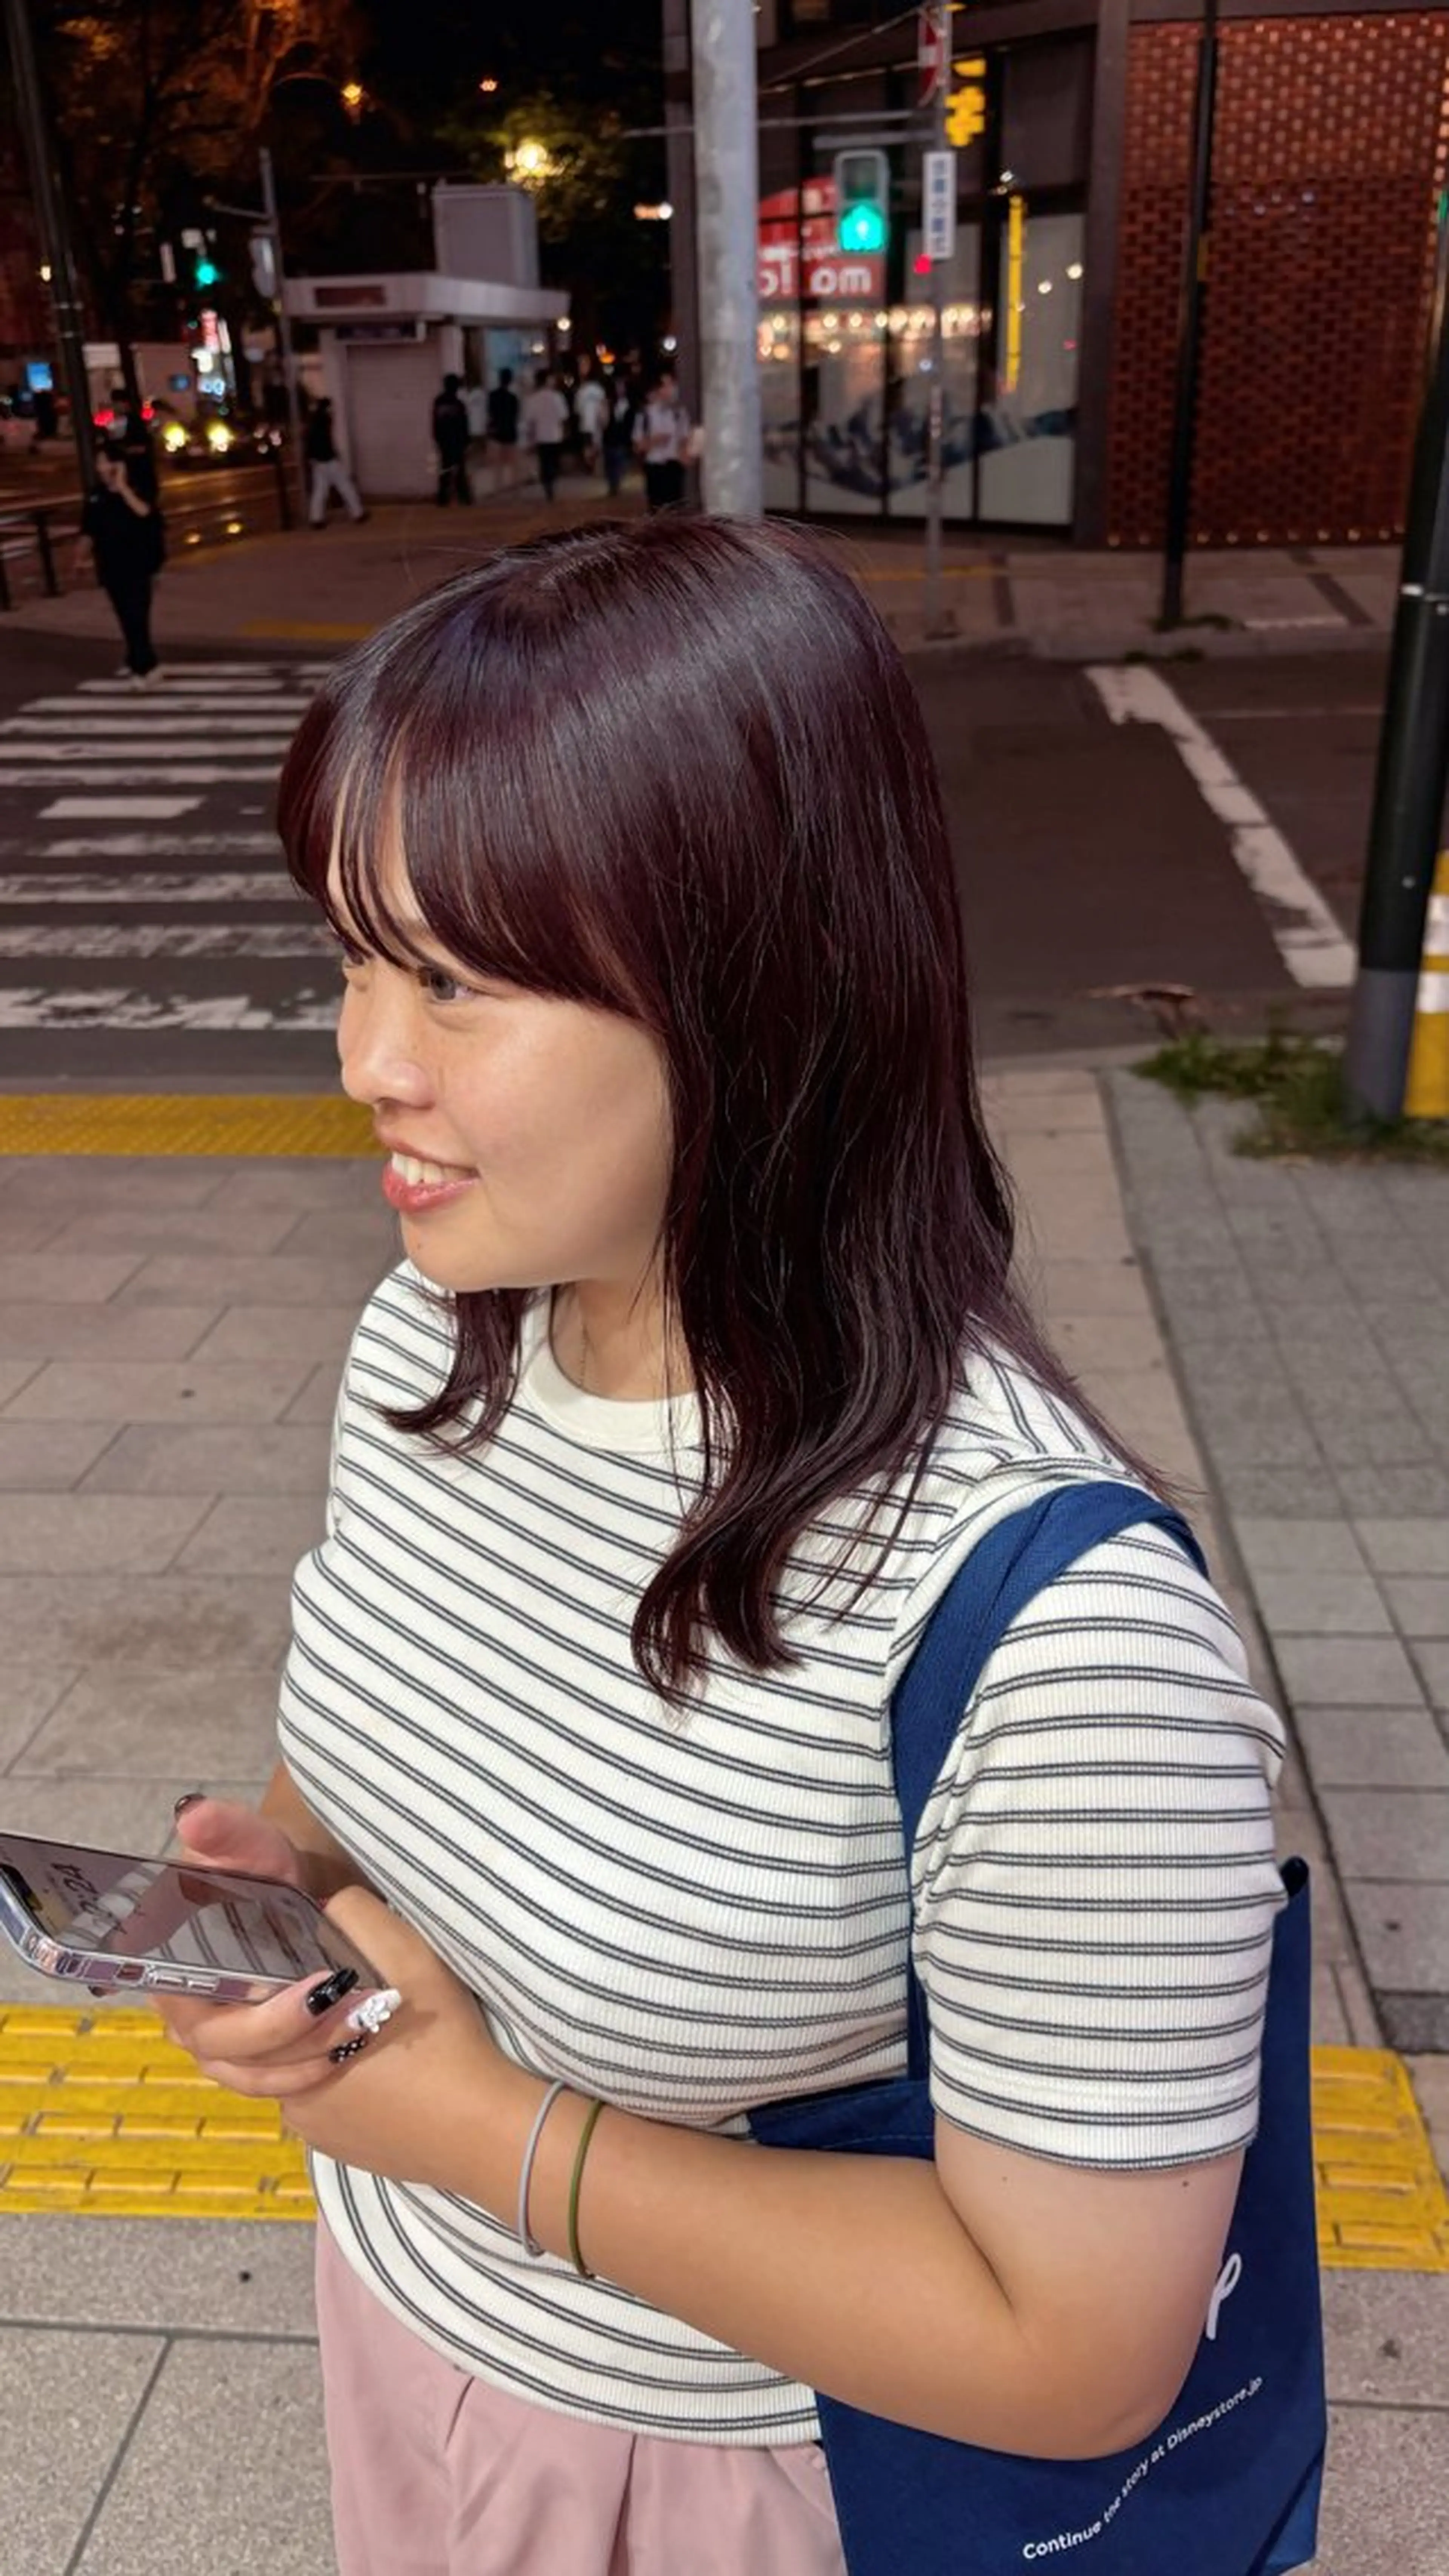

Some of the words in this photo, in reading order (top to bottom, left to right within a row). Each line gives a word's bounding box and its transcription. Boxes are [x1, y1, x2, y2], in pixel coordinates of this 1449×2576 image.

[1022, 2521, 1101, 2559] Continue
[1104, 2496, 1121, 2523] the
[1122, 2459, 1148, 2497] story
[1151, 2445, 1165, 2463] at
[1167, 2377, 1262, 2449] Disneystore.jp
